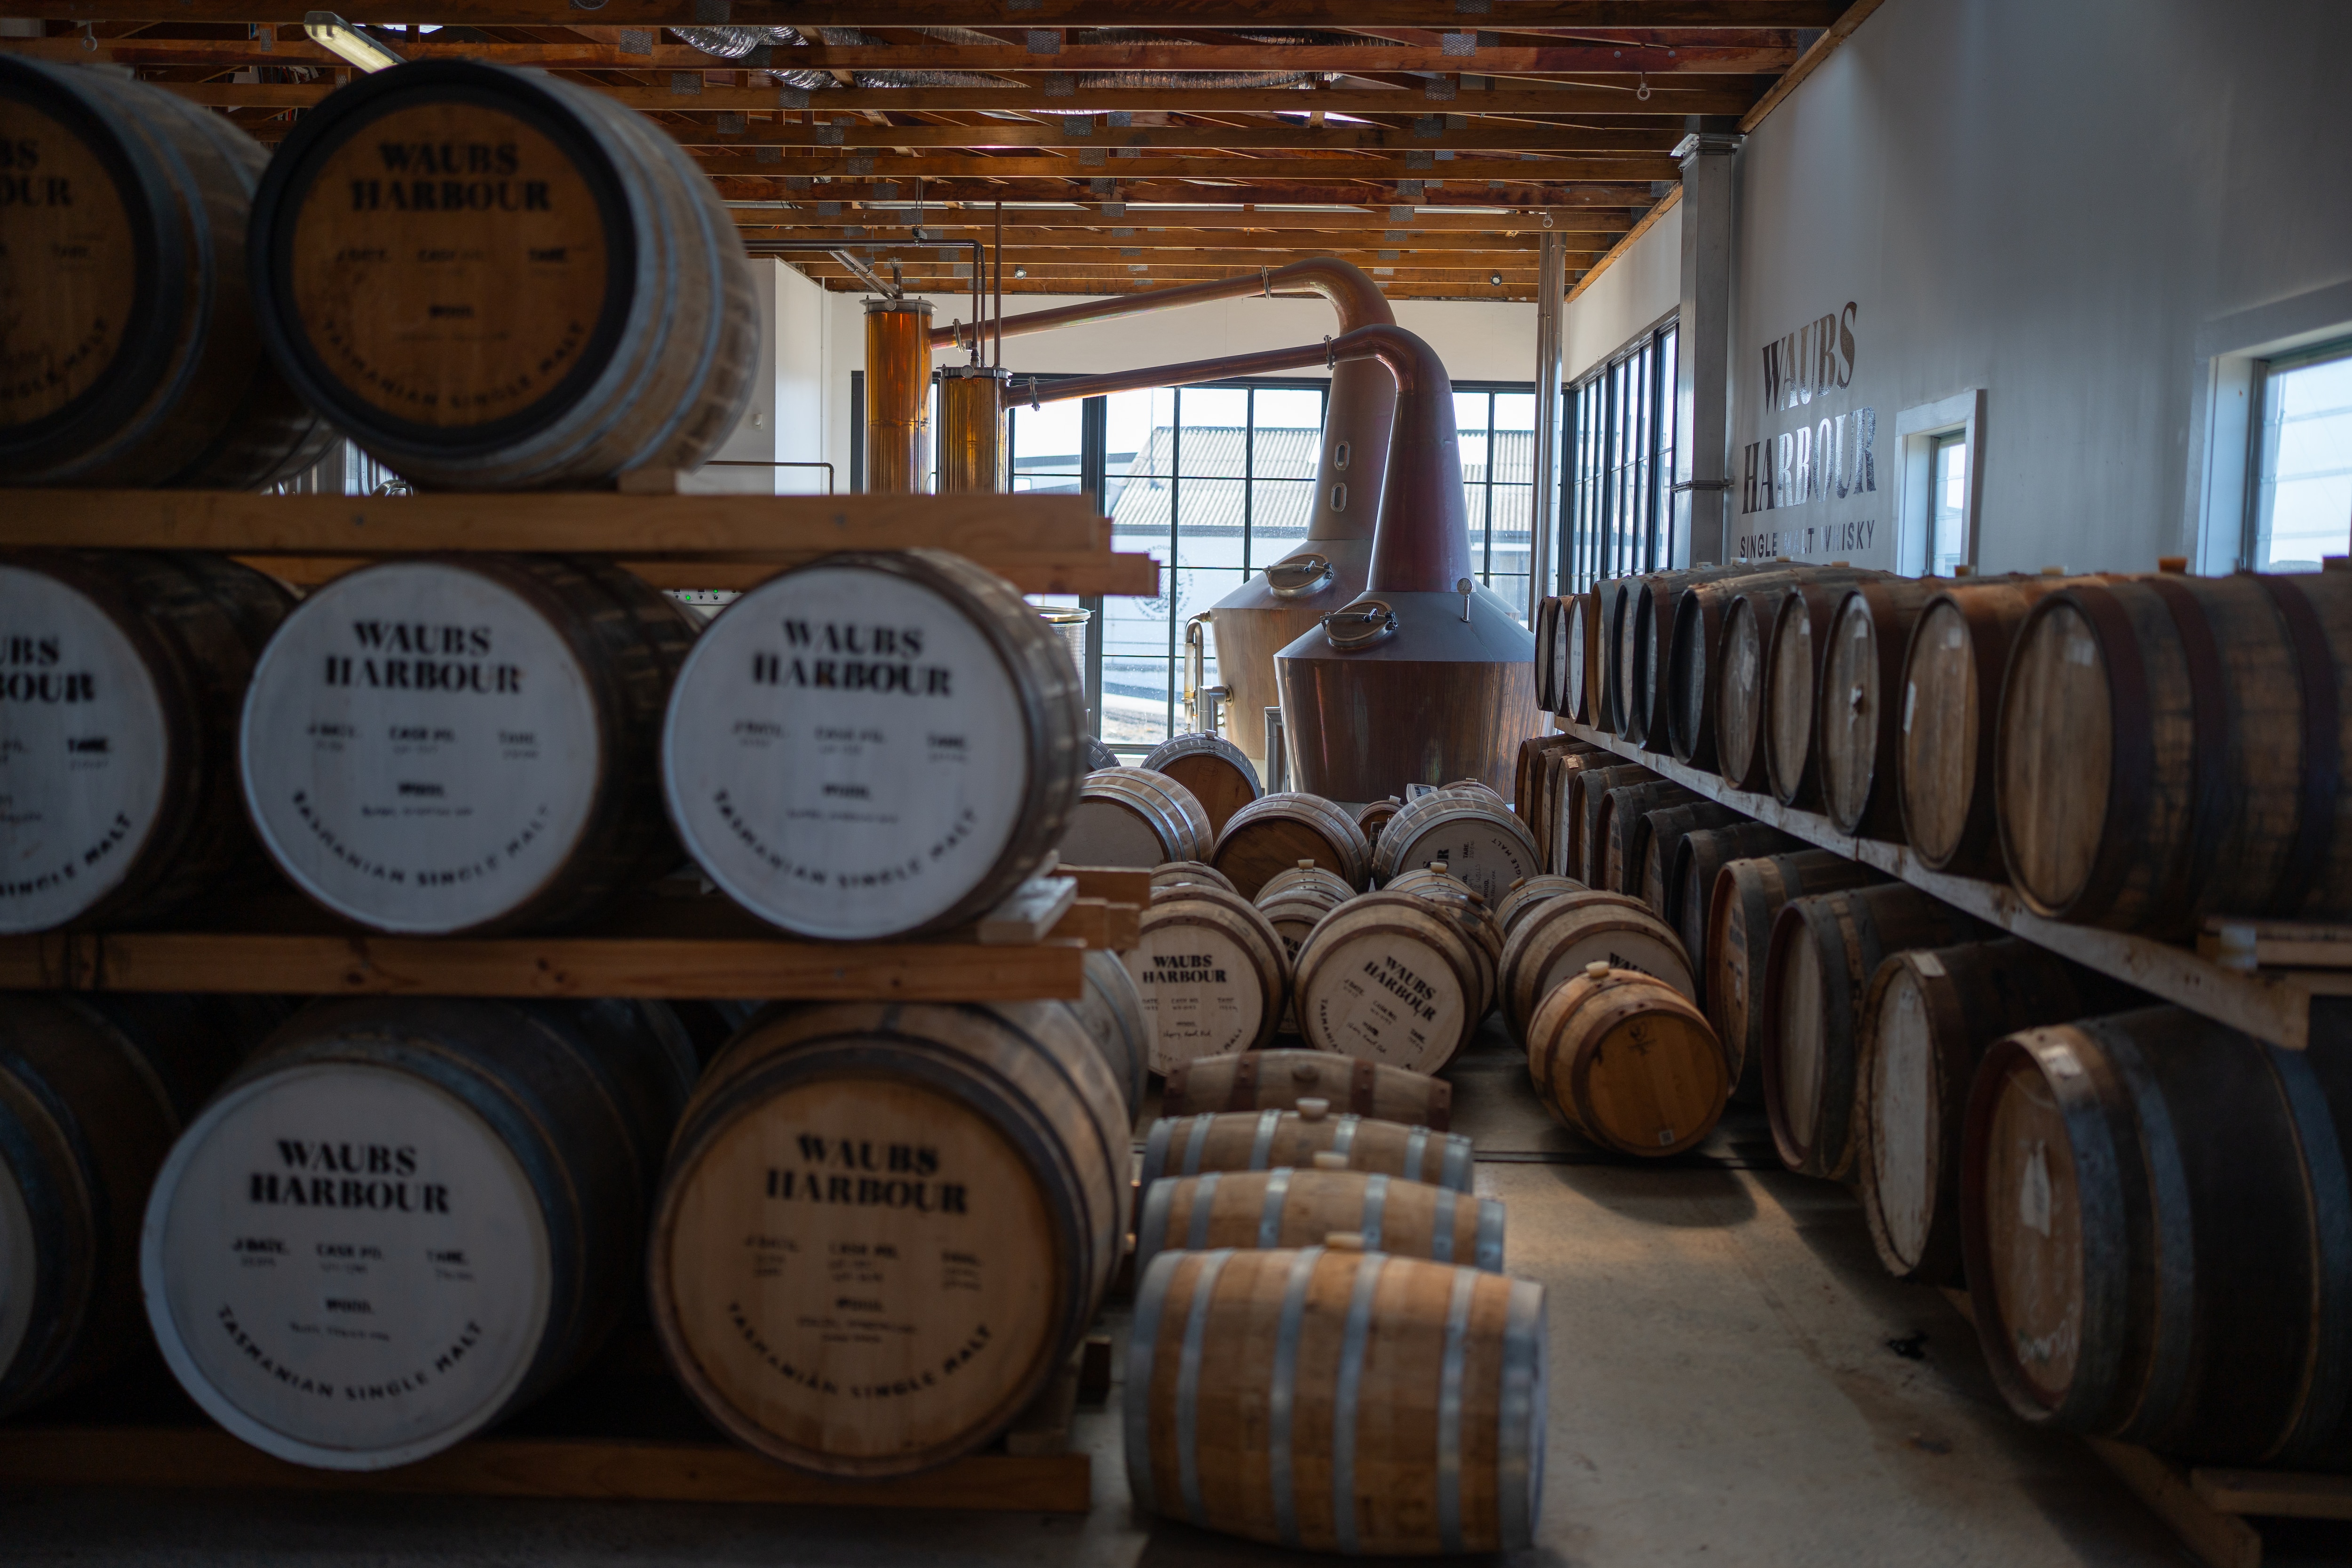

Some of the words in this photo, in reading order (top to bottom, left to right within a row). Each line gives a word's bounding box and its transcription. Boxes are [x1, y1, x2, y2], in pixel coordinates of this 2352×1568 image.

[379, 142, 518, 175] WAUBS
[351, 178, 551, 211] HARBOUR
[1762, 301, 1857, 416] WAUBS
[1742, 406, 1876, 514] HARBOUR
[1740, 532, 1778, 558] SINGLE
[1784, 527, 1814, 556] MALT
[1821, 520, 1875, 552] WHISKY
[354, 621, 493, 657] WAUBS
[785, 620, 923, 660] WAUBS
[326, 654, 522, 694] HARBOUR
[753, 652, 952, 697] HARBOUR
[293, 790, 405, 883] TASMANIAN
[418, 854, 498, 886] SINGLE
[714, 788, 826, 883] TASMANIAN
[837, 856, 922, 887] SINGLE
[1491, 838, 1512, 857] MALT
[1143, 969, 1226, 983] HARBOUR
[1153, 955, 1212, 969] WAUBS
[1387, 955, 1436, 1000] WAUBS
[1363, 961, 1436, 1022] HARBOUR
[278, 1138, 417, 1177] WAUBS
[797, 1132, 939, 1175] WAUBS
[249, 1172, 449, 1215] HARBOUR
[766, 1166, 968, 1215] HARBOUR
[218, 1304, 334, 1398] TASMANIAN
[344, 1370, 427, 1400] SINGLE
[435, 1319, 483, 1372] MALT
[729, 1301, 838, 1396] TASMANIAN
[850, 1371, 936, 1398] SINGLE
[943, 1322, 991, 1374] MALT
